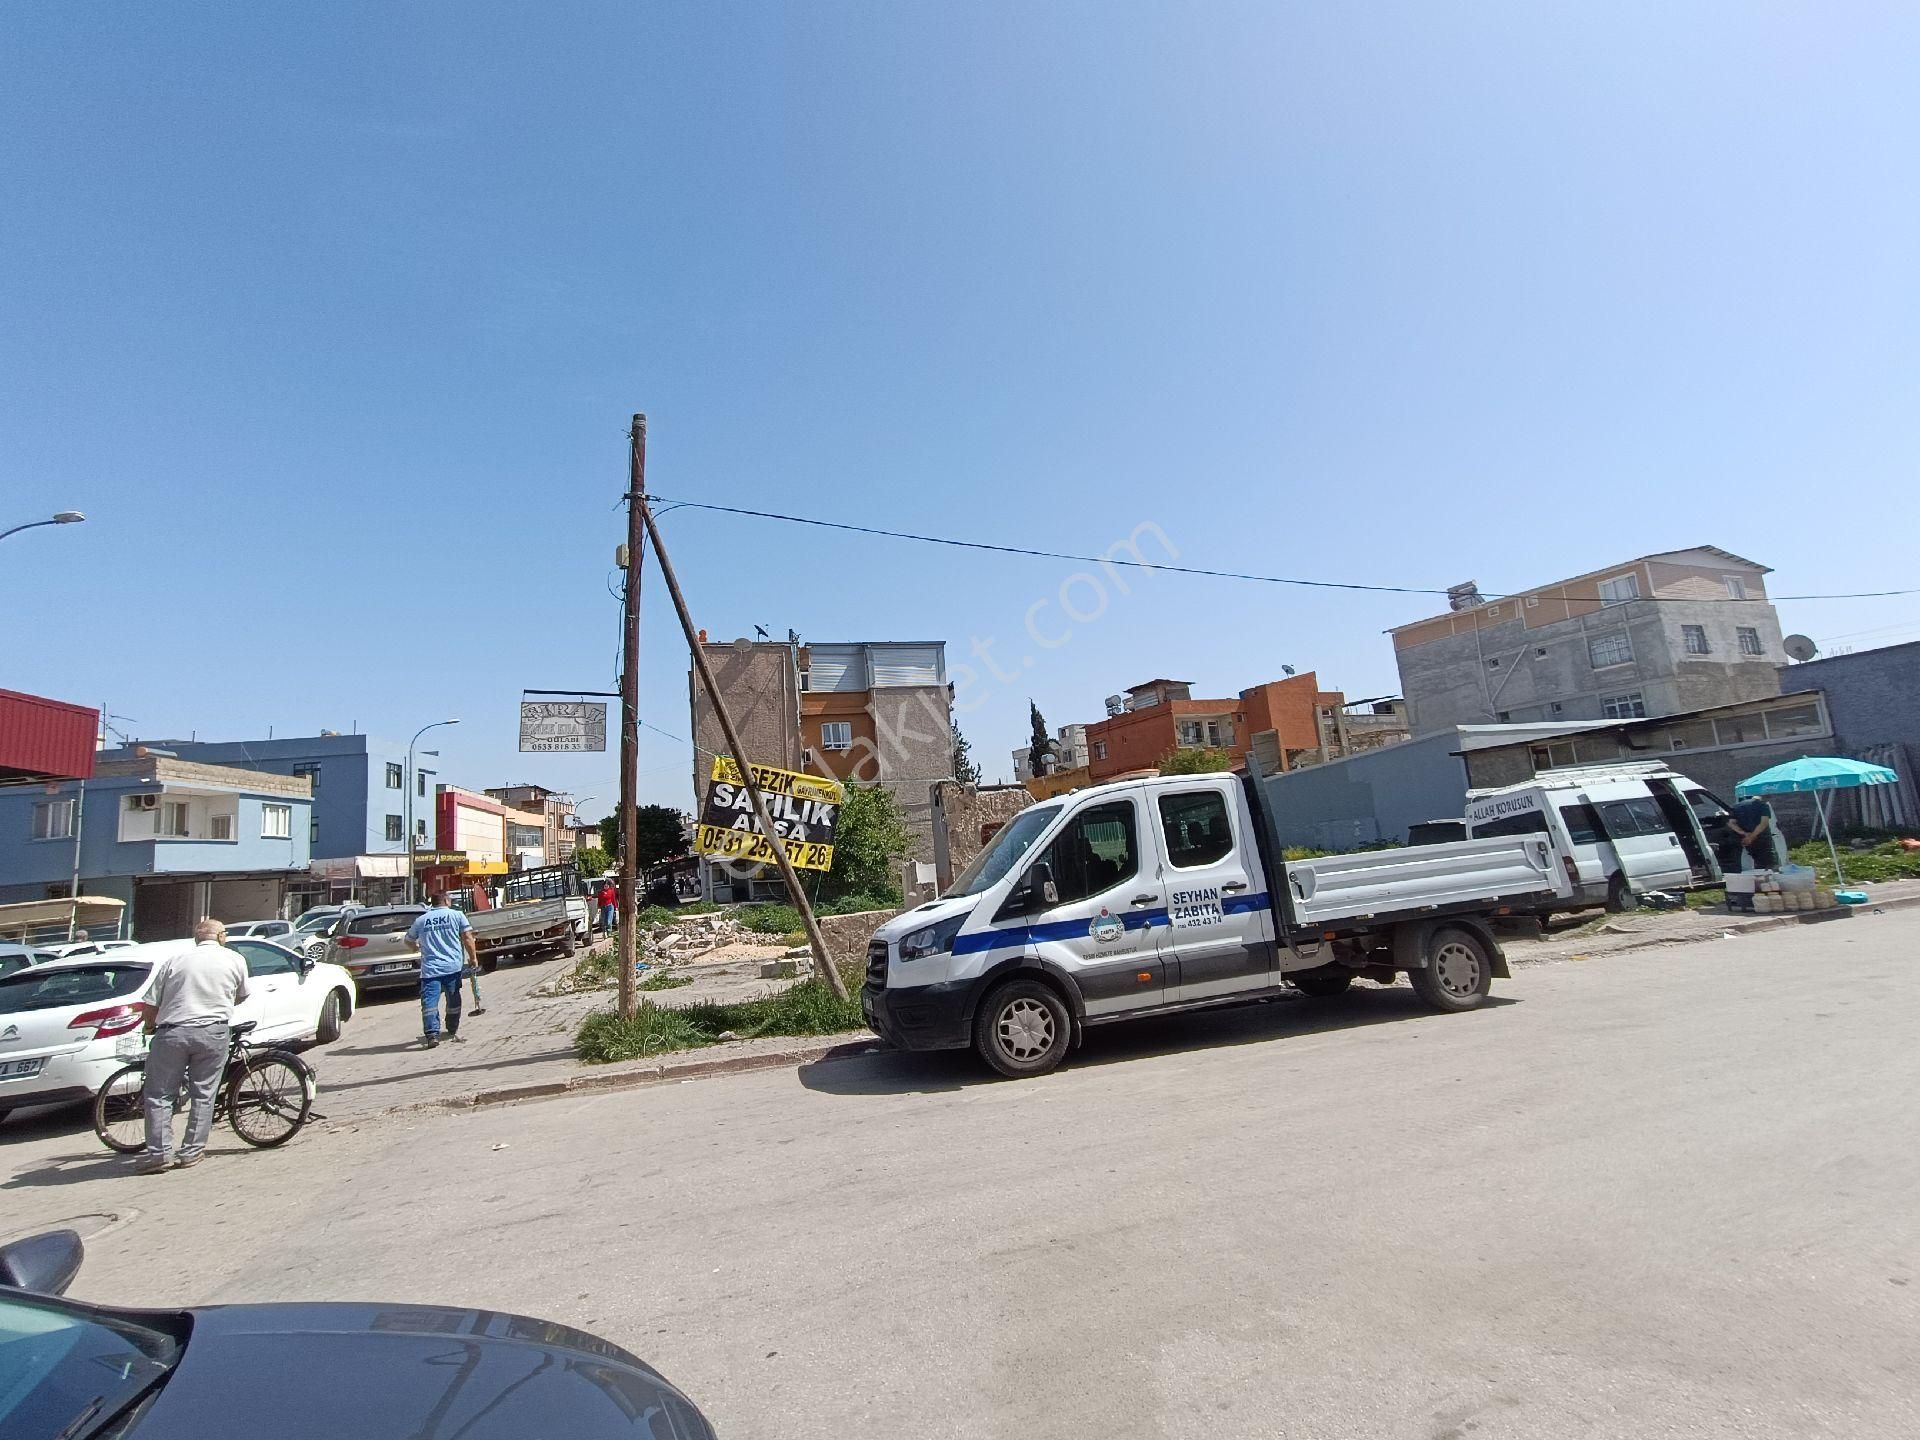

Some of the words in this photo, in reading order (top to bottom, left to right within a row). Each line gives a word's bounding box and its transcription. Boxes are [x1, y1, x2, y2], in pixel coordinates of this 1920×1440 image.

[713, 783, 835, 827] SATILIK
[1474, 804, 1495, 821] ALLAH
[1496, 795, 1534, 816] KORUSUN
[747, 835, 774, 860] 25
[807, 844, 827, 866] 26
[1173, 888, 1218, 904] SEYHAN
[1174, 903, 1220, 919] ZABITA
[1188, 918, 1201, 927] 432
[1203, 917, 1211, 925] 43
